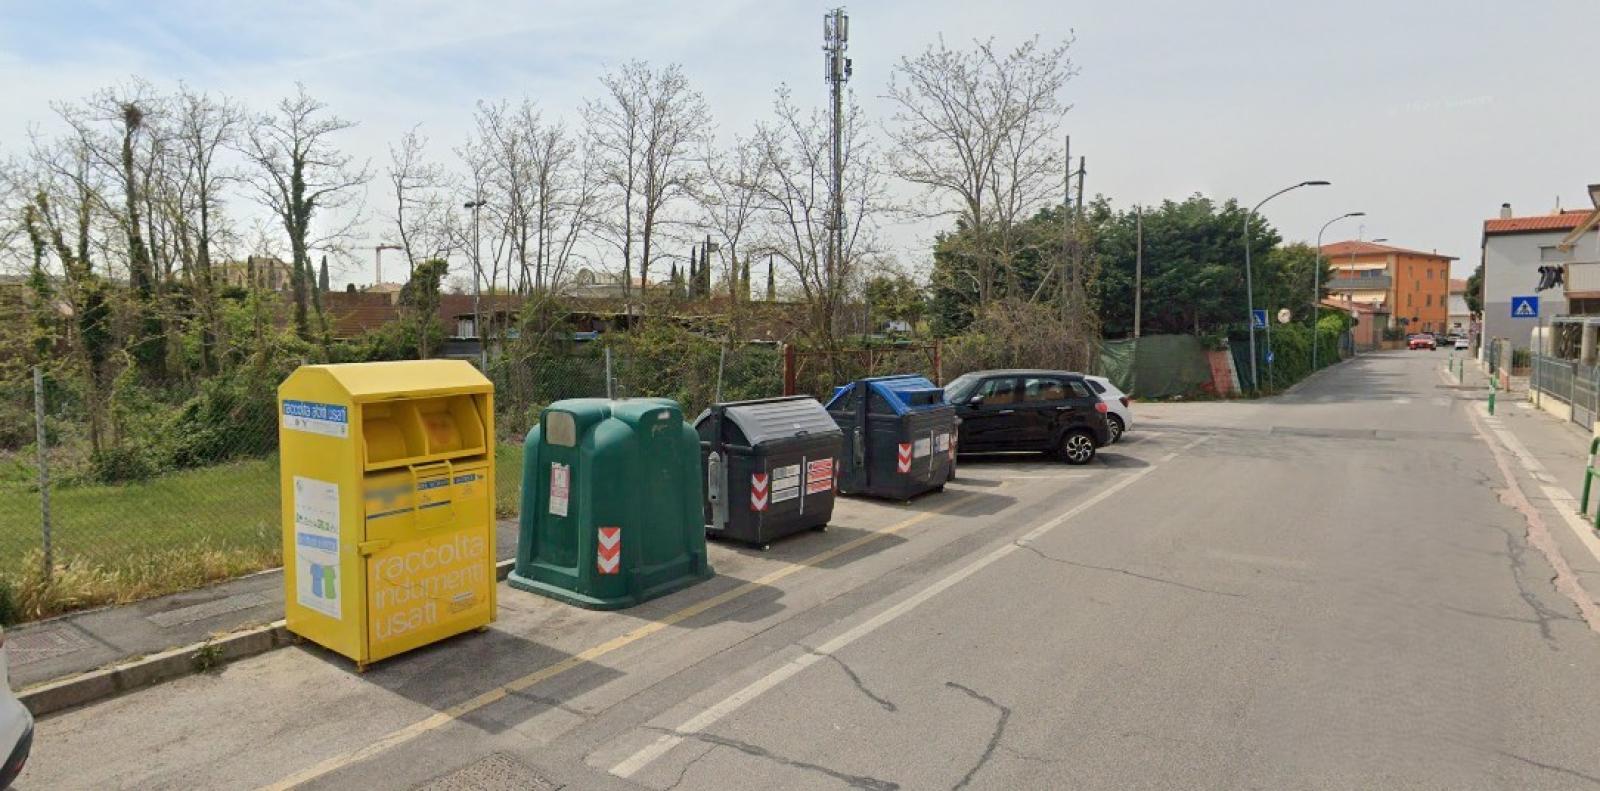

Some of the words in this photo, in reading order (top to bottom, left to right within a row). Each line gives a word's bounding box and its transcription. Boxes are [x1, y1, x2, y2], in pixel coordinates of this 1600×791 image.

[375, 533, 485, 580] raccolta
[376, 562, 485, 610] indumenti
[376, 601, 437, 640] usati
